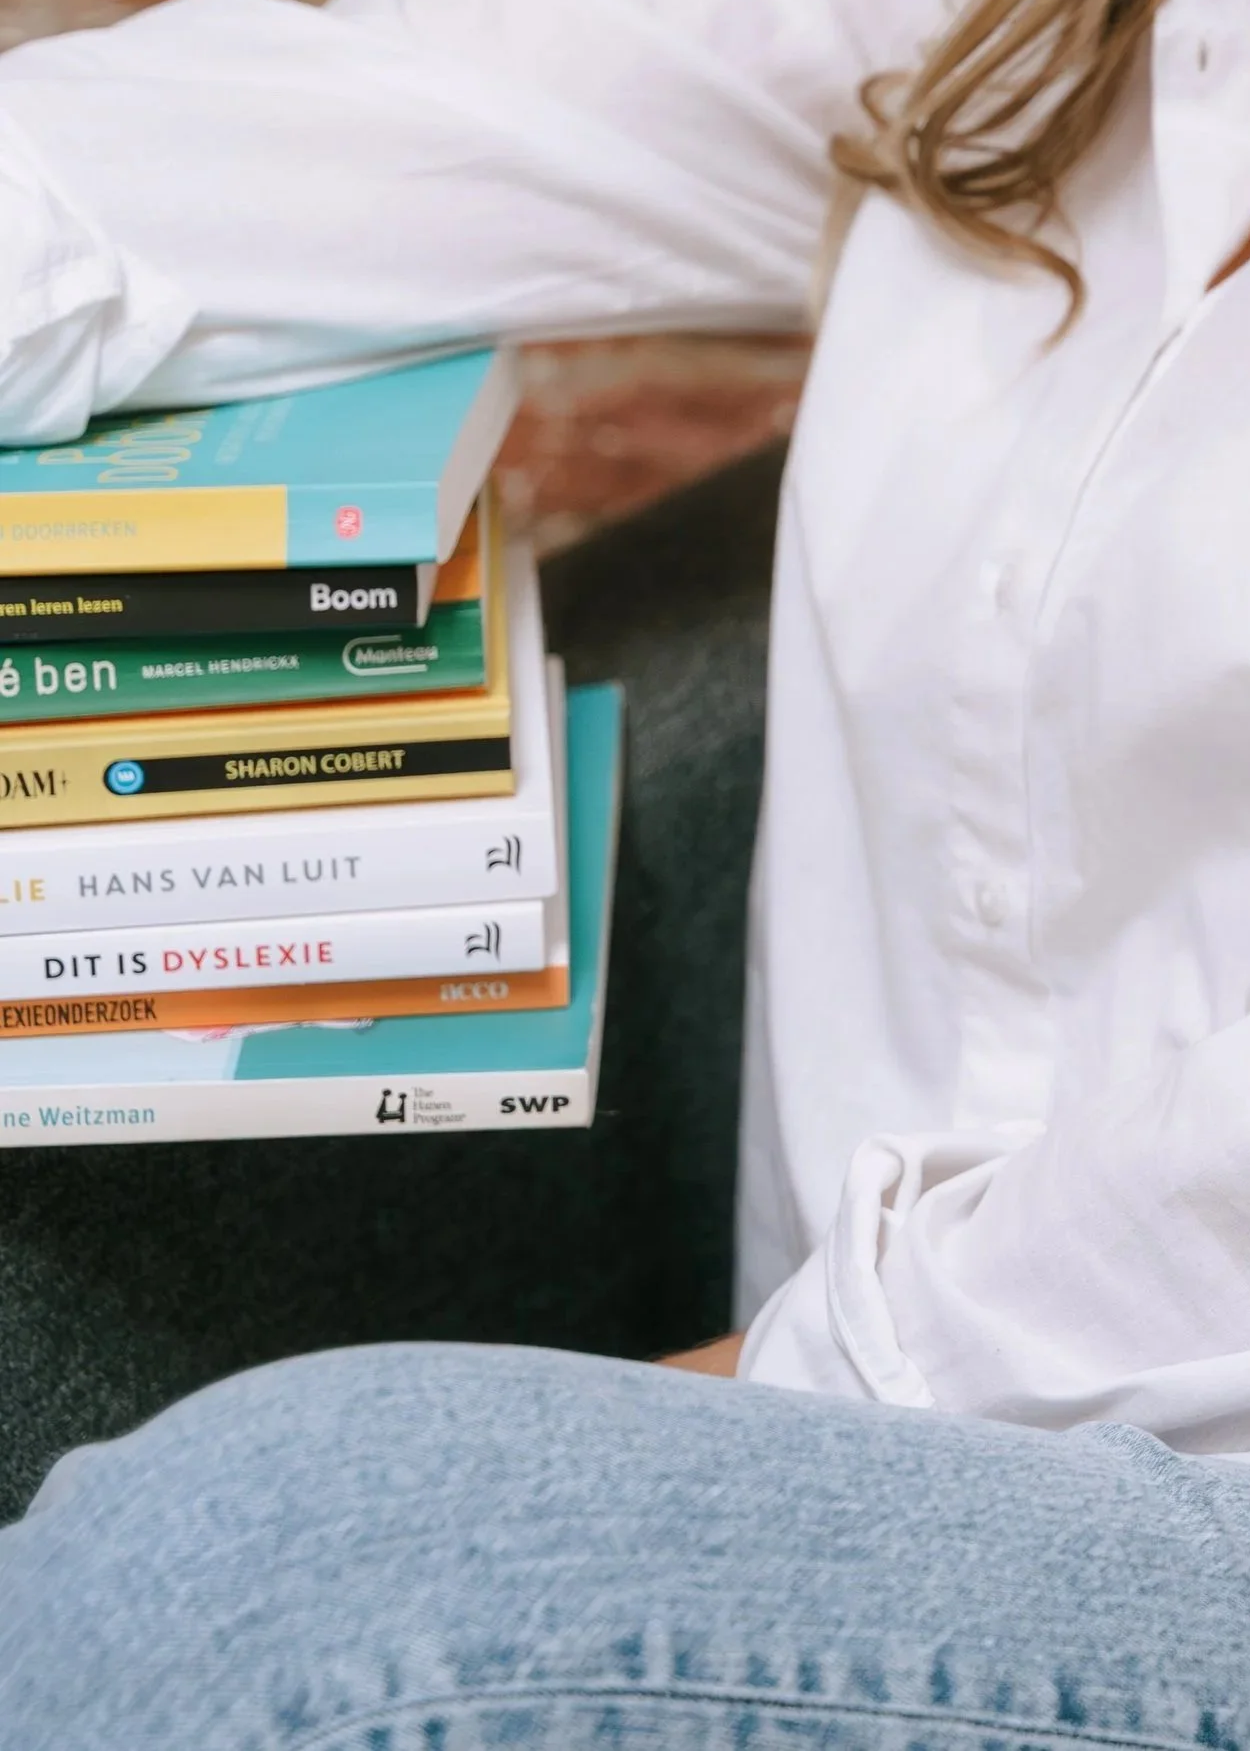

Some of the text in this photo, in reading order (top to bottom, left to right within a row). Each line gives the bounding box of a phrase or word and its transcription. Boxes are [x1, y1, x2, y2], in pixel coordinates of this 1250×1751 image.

[12, 519, 137, 541] DOORBREKEN
[30, 598, 74, 615] leren
[77, 596, 123, 614] lezen
[310, 583, 398, 611] Boom
[34, 656, 117, 695] ben
[142, 663, 205, 680] MARCEL
[208, 655, 300, 674] HENDRICKX
[224, 750, 406, 780] SHARON COBERT
[78, 869, 176, 897] HANS
[192, 864, 265, 888] VAN
[282, 857, 361, 884] LUIT
[45, 942, 334, 979] DIT IS DYSLEXIE
[440, 981, 509, 1001] acco
[3, 1106, 156, 1127] ne Weitzman
[500, 1096, 570, 1114] SWP
